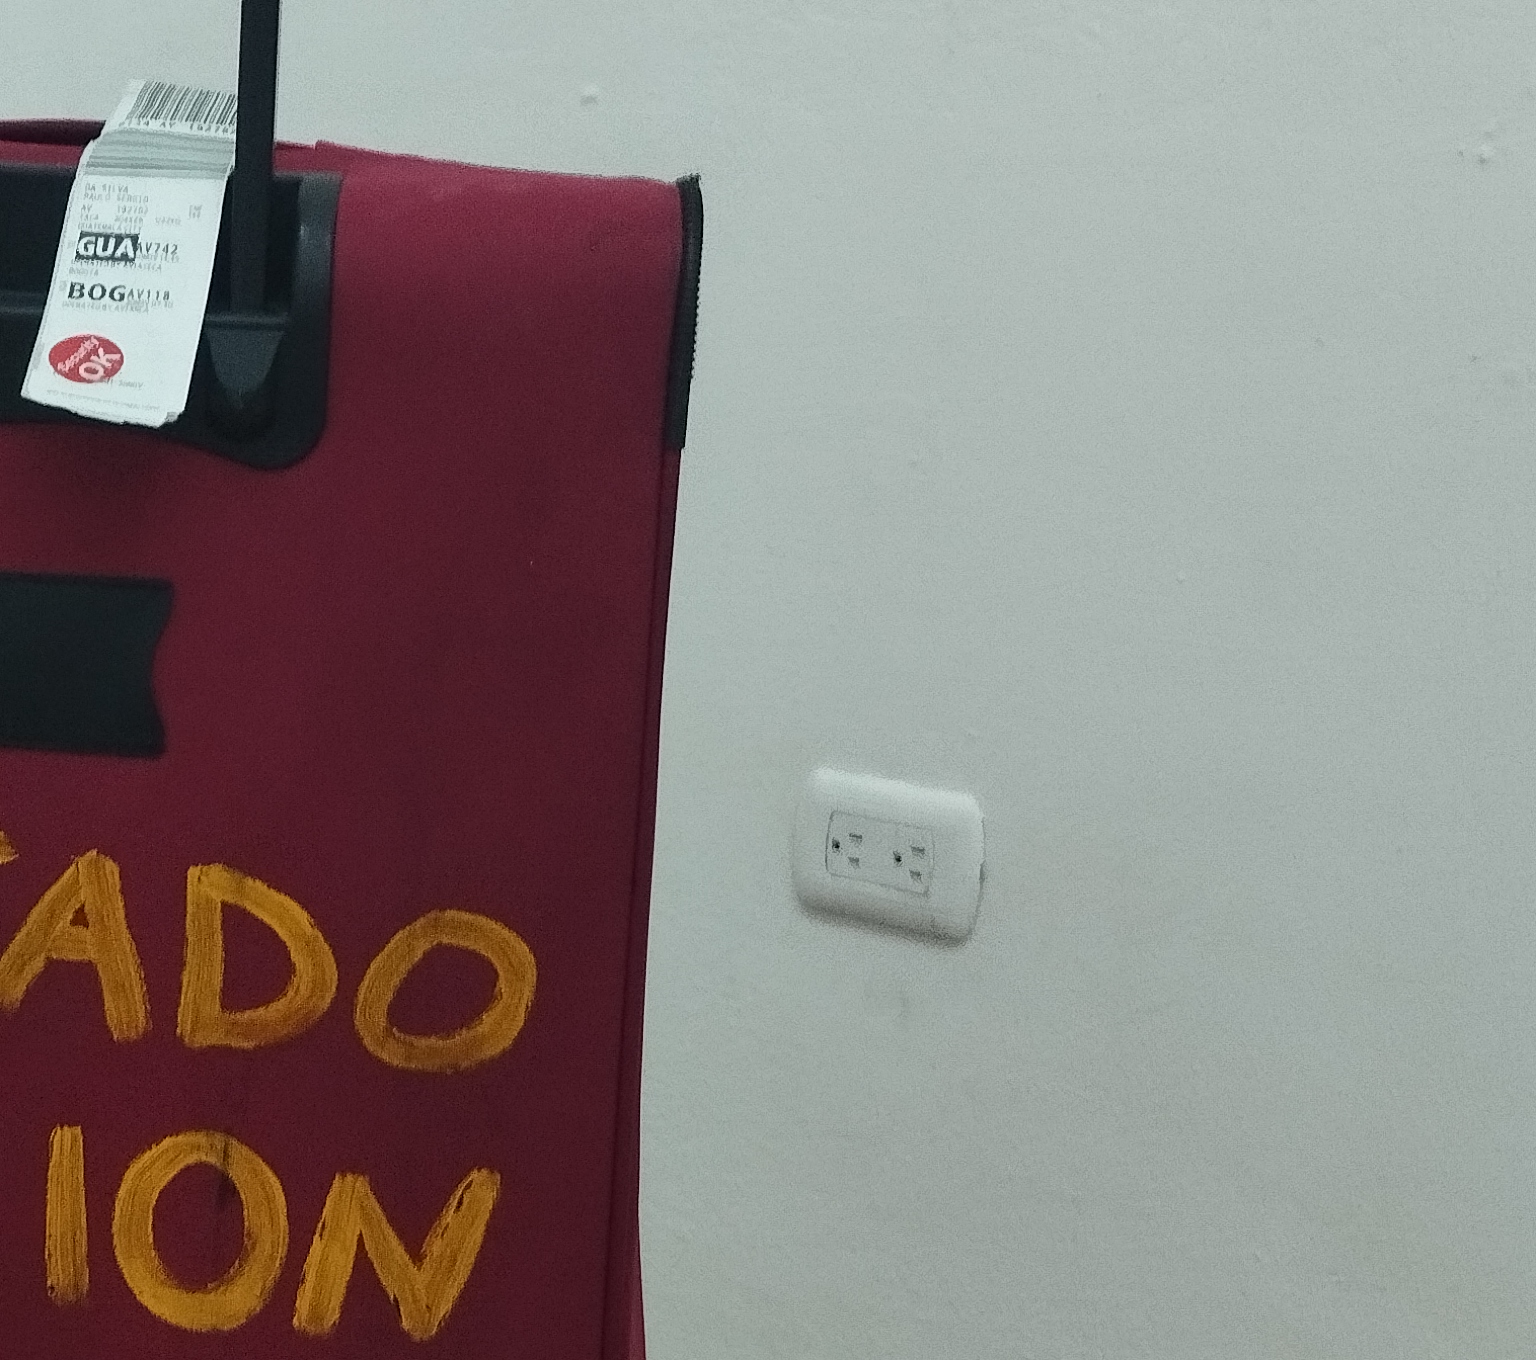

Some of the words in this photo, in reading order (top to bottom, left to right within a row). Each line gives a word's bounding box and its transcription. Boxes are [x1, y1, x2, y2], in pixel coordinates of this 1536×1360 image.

[102, 183, 129, 194] SILVA
[77, 235, 135, 259] GUA
[67, 281, 126, 302] BOG
[78, 346, 122, 381] OK
